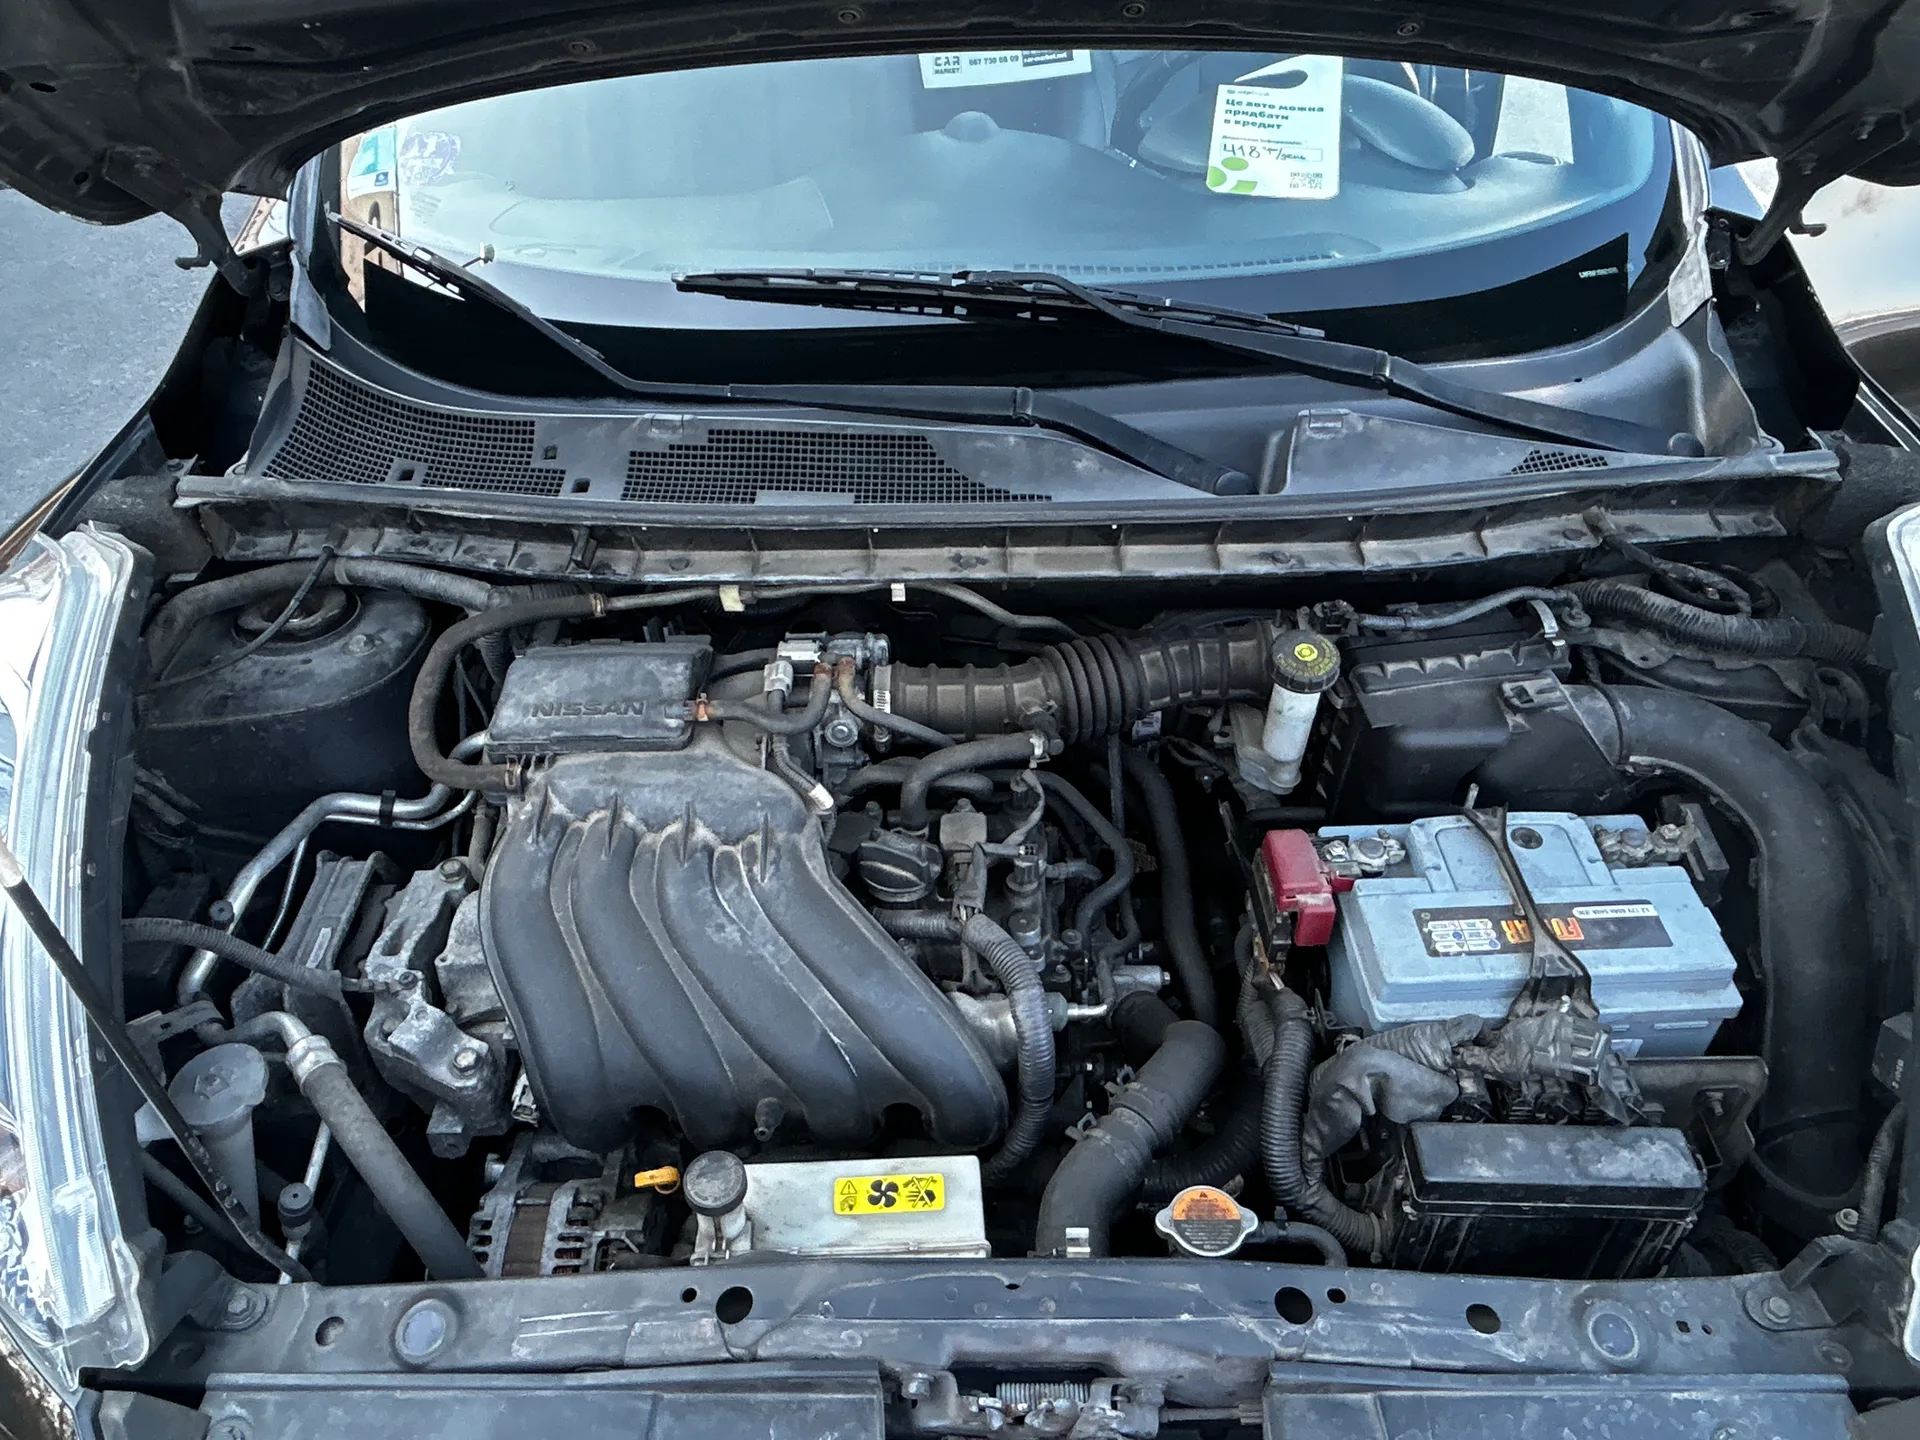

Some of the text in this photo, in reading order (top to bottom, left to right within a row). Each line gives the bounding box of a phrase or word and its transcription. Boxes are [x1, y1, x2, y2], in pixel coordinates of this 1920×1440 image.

[935, 56, 960, 66] CAR
[1226, 99, 1243, 107] Це
[1246, 101, 1276, 109] авто
[1225, 109, 1289, 120] придбати
[1234, 120, 1283, 130] кредит
[1223, 143, 1260, 159] 418
[531, 701, 647, 717] NISSAN
